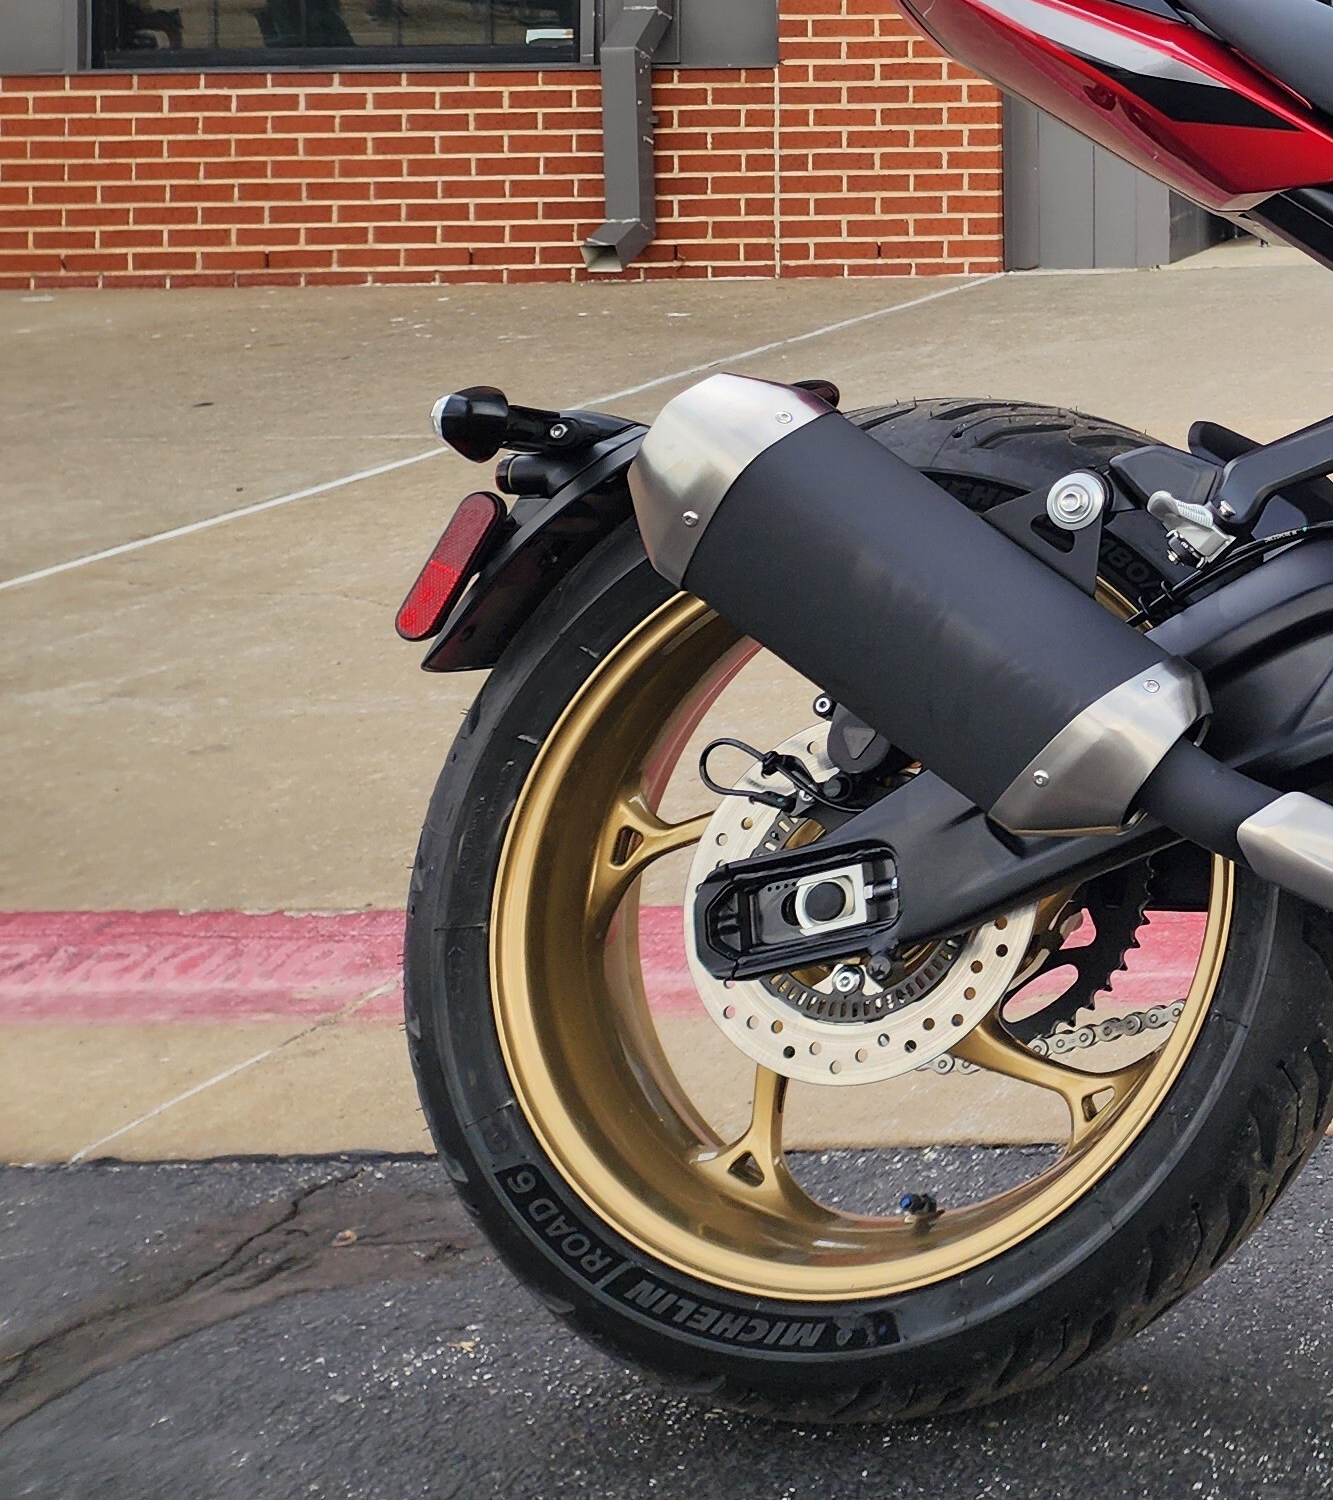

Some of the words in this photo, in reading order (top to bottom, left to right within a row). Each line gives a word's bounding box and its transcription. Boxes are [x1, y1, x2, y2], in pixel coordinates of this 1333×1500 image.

[507, 1171, 537, 1194] 6
[527, 1198, 613, 1274] ROAD
[623, 1279, 827, 1347] MICHELIN
